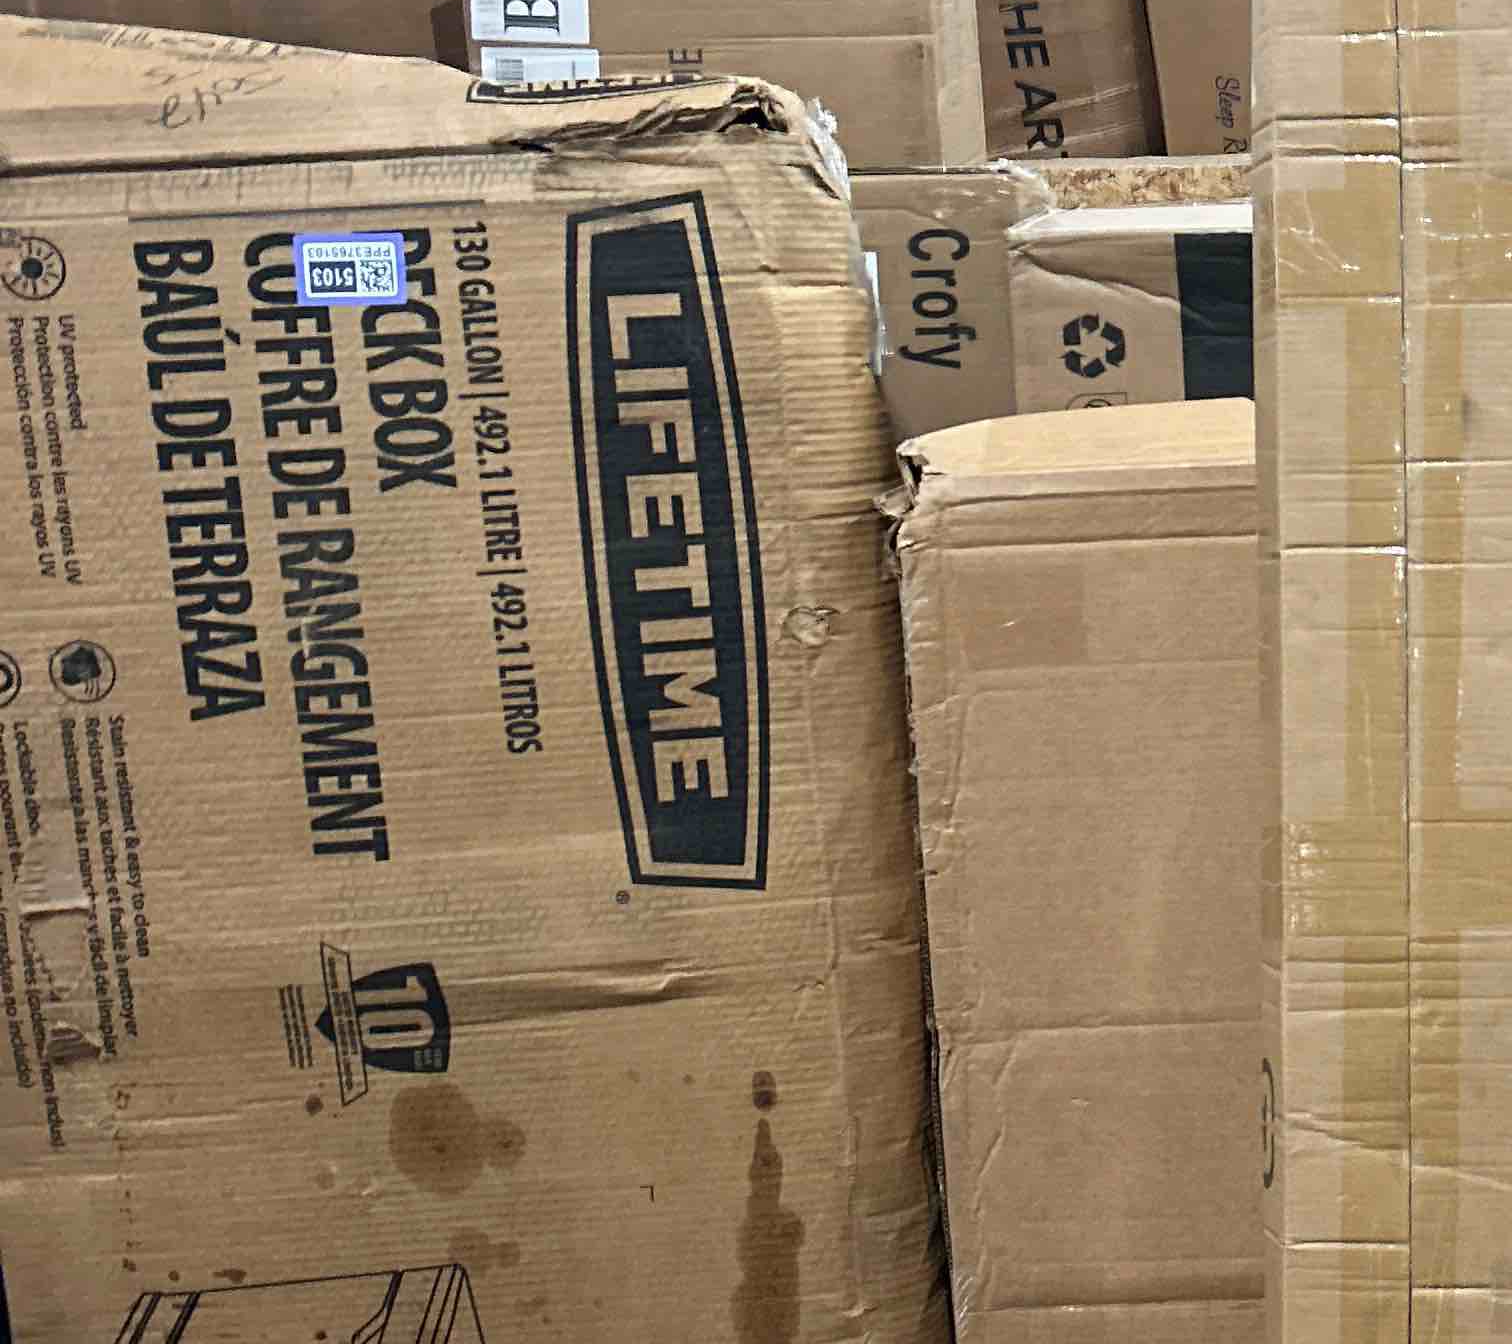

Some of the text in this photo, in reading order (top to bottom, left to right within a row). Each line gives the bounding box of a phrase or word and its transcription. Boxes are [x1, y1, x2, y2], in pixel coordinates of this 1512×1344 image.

[1015, 80, 1068, 158] AR
[307, 246, 391, 258] PPE3765103
[311, 266, 355, 288] 5103
[452, 221, 491, 272] 130
[133, 239, 240, 391] BAÚL
[458, 276, 506, 385] GALLON
[898, 228, 977, 369] Crofy
[57, 314, 87, 430] UV protected
[19, 415, 38, 471] contra
[32, 316, 82, 586] Protection contre les rayons UV
[152, 398, 239, 471] DE
[369, 377, 459, 493] BOX
[473, 405, 514, 480] 492.1
[28, 474, 44, 499] los
[30, 502, 49, 548] rayos
[244, 232, 391, 862] COFFRE DE RANGEMENT
[479, 488, 522, 562] LITRE
[606, 291, 730, 804] LIFETIME
[38, 553, 57, 578] UV
[162, 476, 266, 722] TERRAZA
[489, 582, 531, 656] 492.1
[108, 714, 129, 757] Stain
[498, 661, 543, 756] LITROS
[114, 761, 136, 831] resistant
[126, 852, 143, 888] easy
[132, 893, 145, 910] to
[134, 914, 150, 958] clean
[353, 976, 435, 1049] 10
